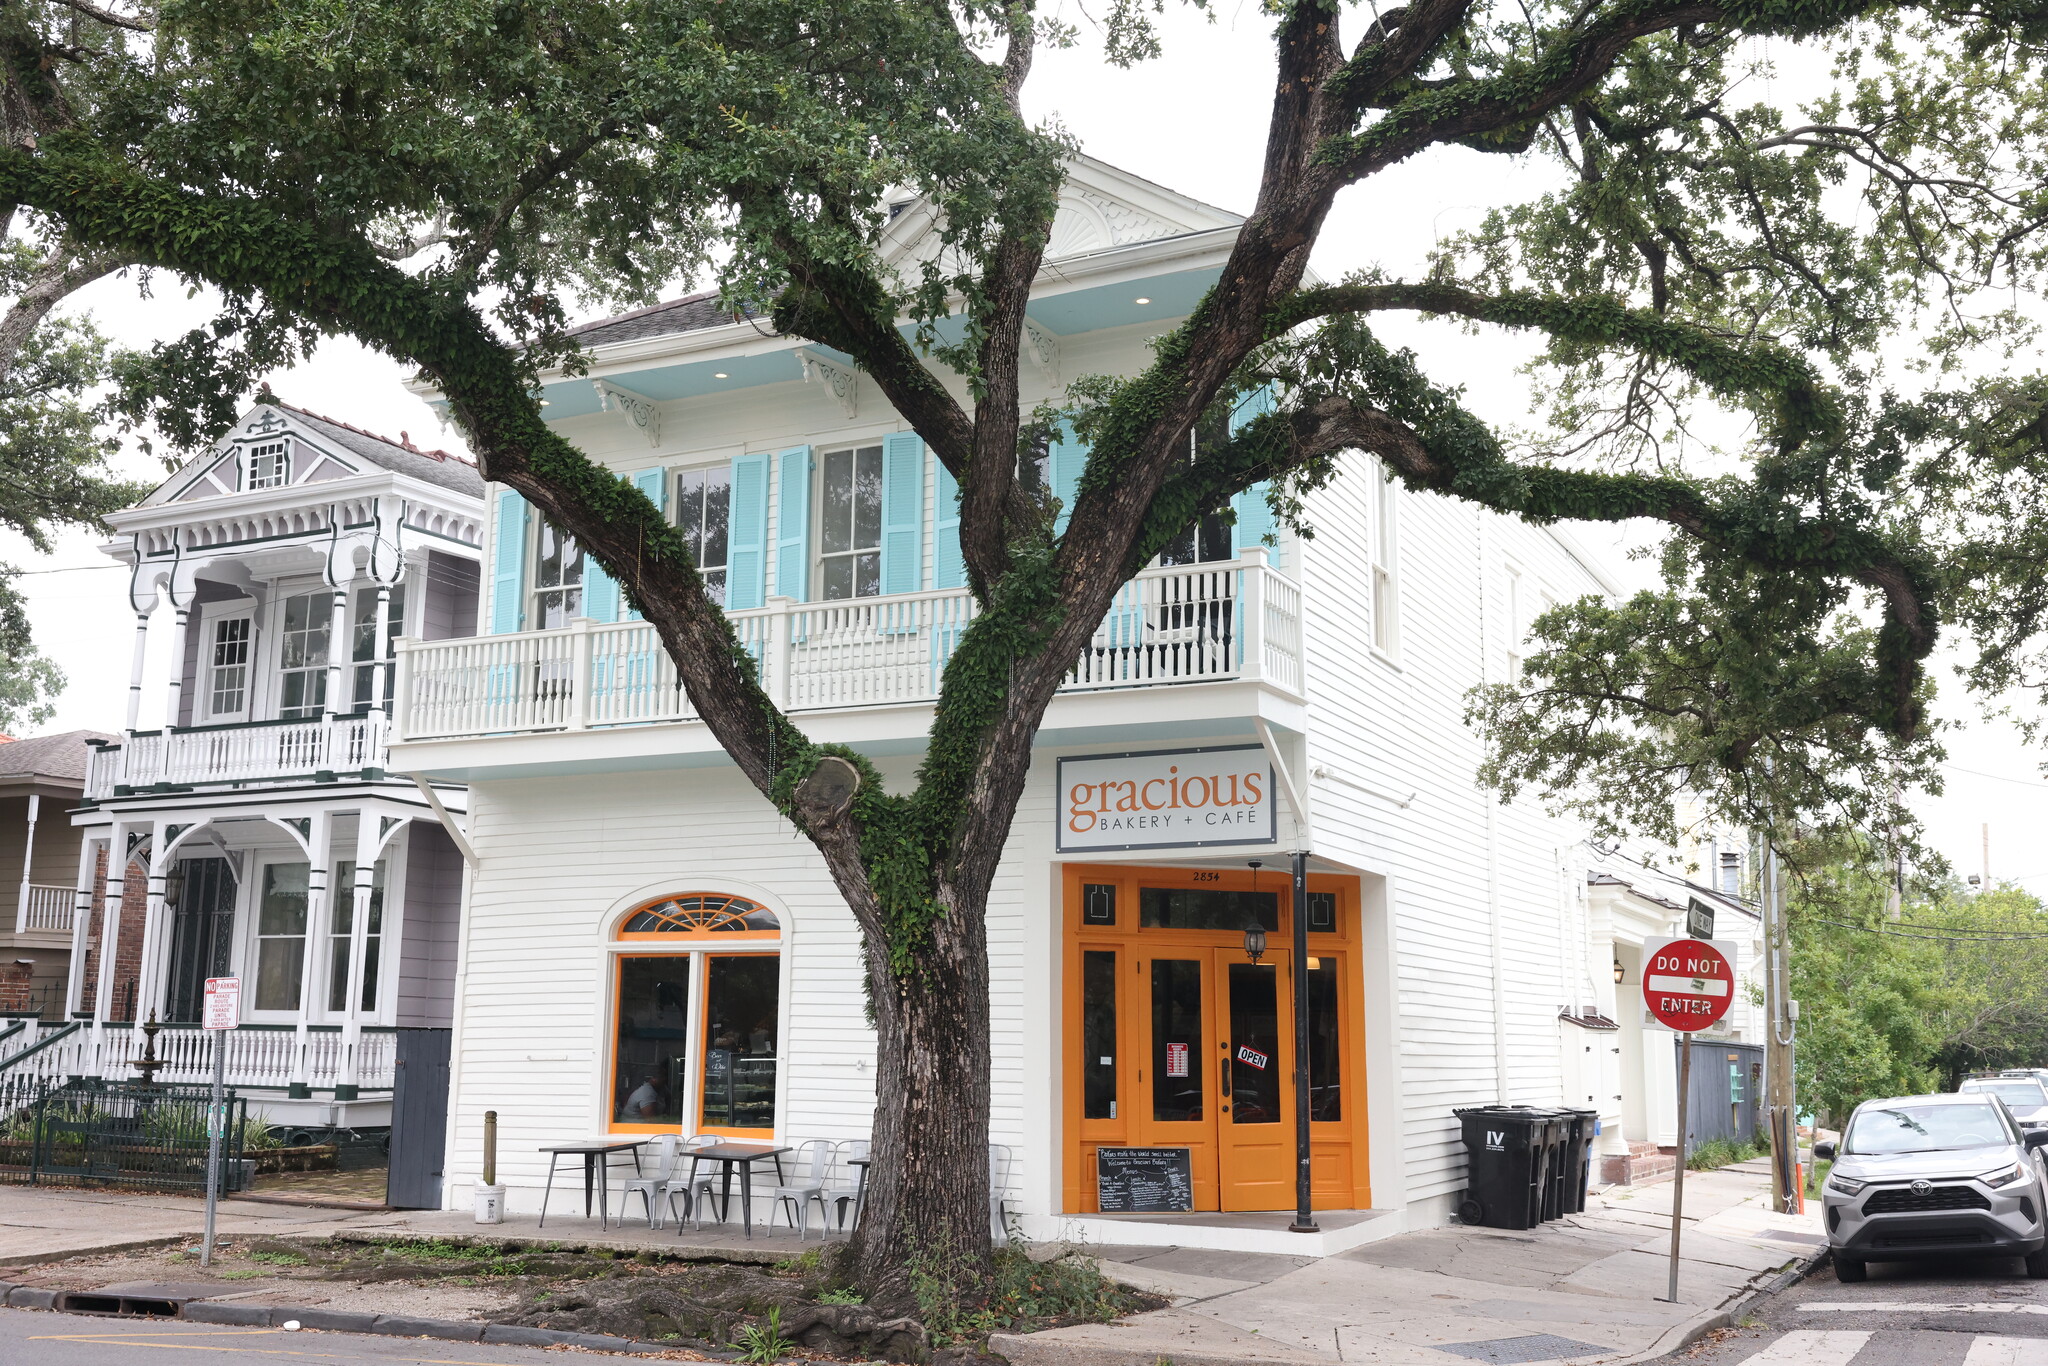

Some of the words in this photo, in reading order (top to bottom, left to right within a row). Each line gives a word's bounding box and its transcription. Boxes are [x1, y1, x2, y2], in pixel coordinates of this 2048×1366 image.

[1068, 765, 1262, 833] gracious
[1100, 814, 1172, 831] BAKERY
[1205, 806, 1256, 826] CAFÉ
[1193, 872, 1220, 882] 2854
[1694, 911, 1703, 928] ONE
[1657, 956, 1680, 971] DO
[1687, 958, 1721, 974] NOT
[206, 981, 216, 992] NO
[217, 982, 238, 990] PARKING
[1660, 997, 1712, 1015] ENTER
[1241, 1049, 1265, 1067] OPEN
